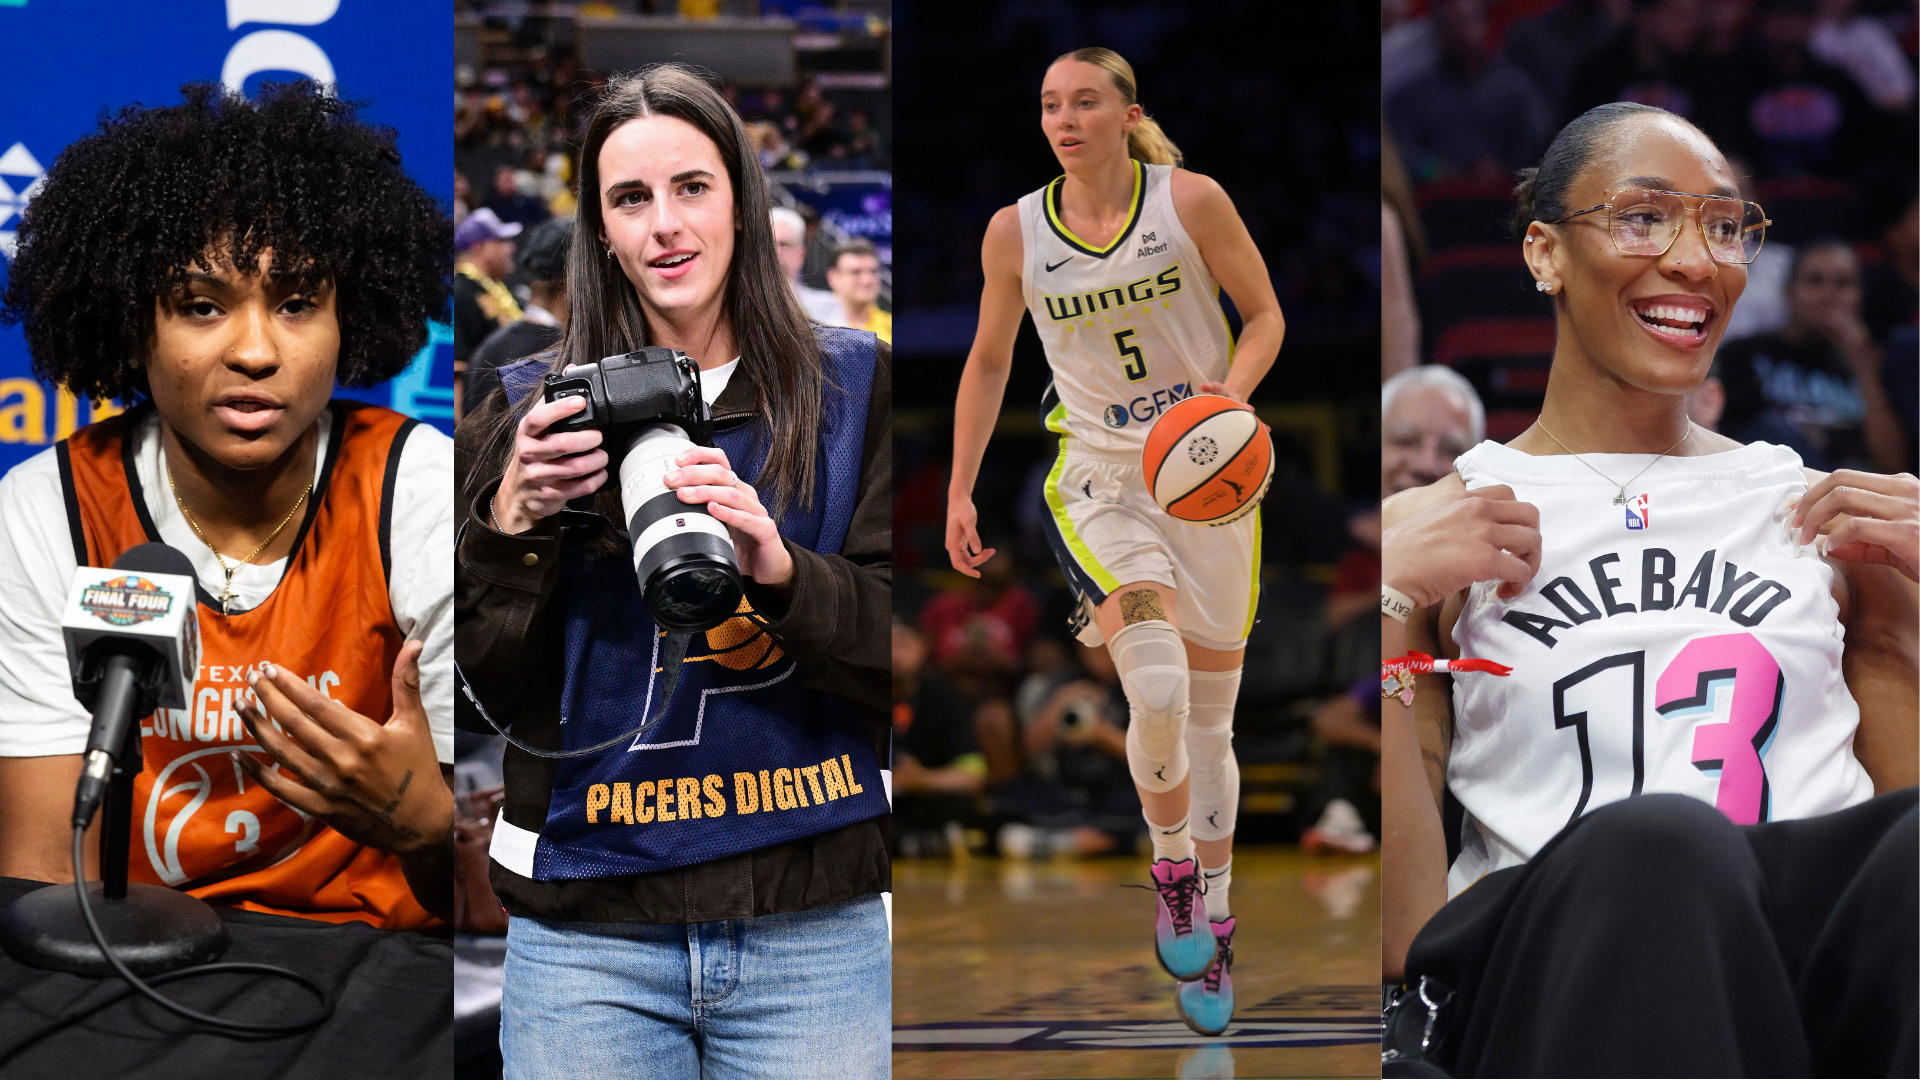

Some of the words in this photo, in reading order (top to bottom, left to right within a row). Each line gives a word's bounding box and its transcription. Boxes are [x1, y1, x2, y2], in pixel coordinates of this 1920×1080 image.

[1137, 242, 1168, 259] Albert
[1043, 262, 1182, 323] WINGS
[1111, 326, 1150, 383] 5
[1628, 518, 1641, 528] NBA
[83, 589, 126, 607] FINAL
[128, 593, 170, 610] FOUR
[1391, 602, 1411, 618] EAT
[1501, 547, 1792, 649] ADEBAYO
[1552, 632, 1786, 828] 13
[586, 773, 727, 825] PACERS
[733, 754, 864, 815] DIGITAL
[225, 809, 260, 852] 3
